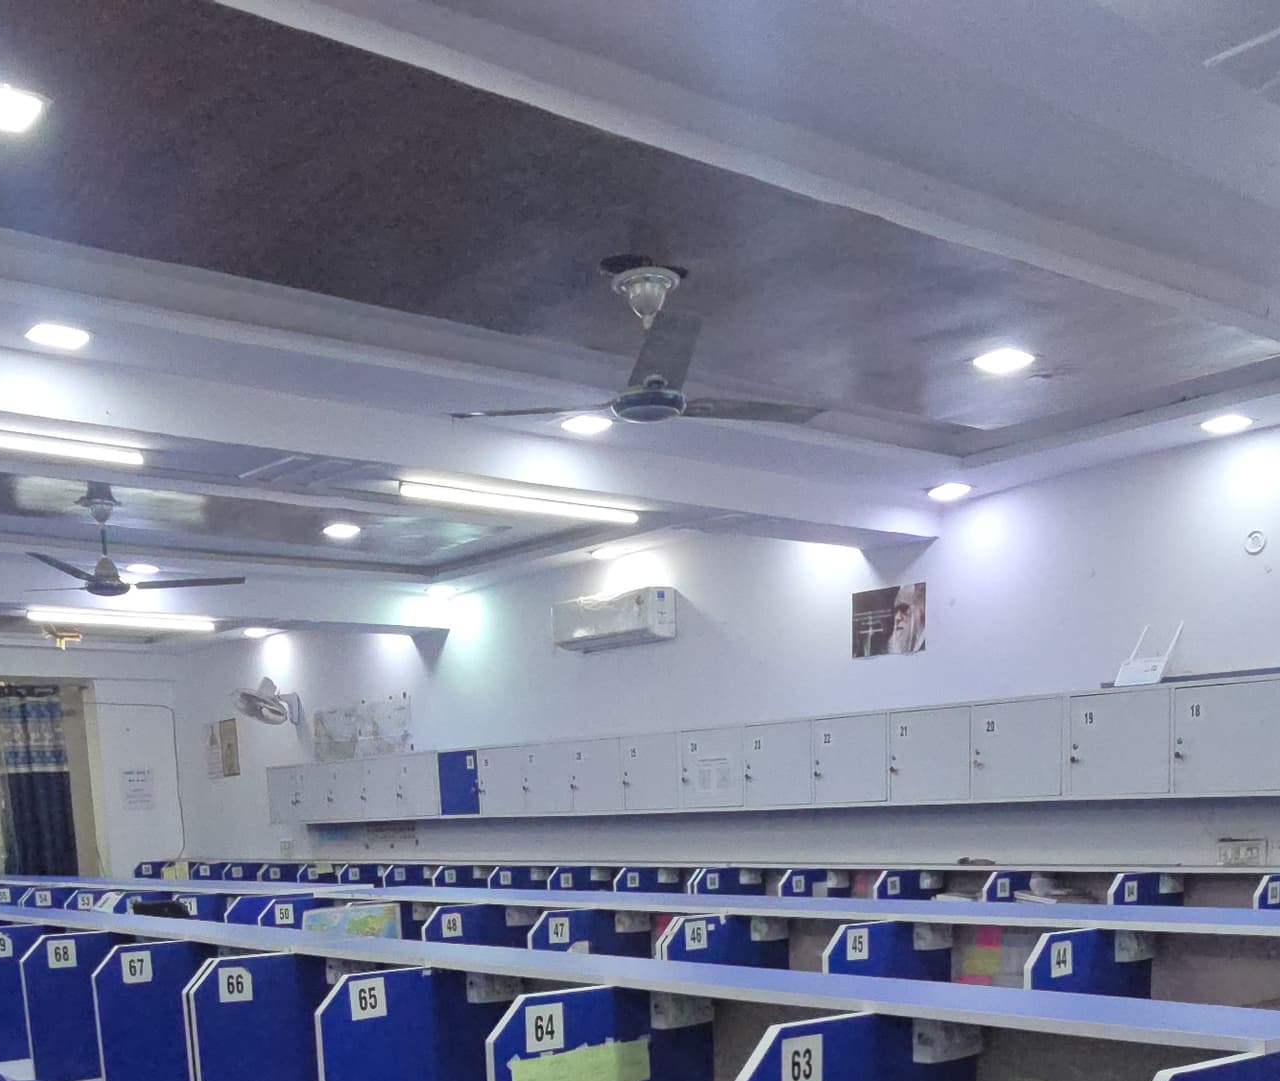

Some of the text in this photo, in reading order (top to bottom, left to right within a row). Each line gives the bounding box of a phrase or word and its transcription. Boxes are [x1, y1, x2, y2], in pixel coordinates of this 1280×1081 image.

[1190, 704, 1201, 718] 18
[899, 725, 908, 737] 21
[986, 720, 995, 732] 20
[279, 908, 290, 920] 50
[446, 918, 457, 932] 48
[553, 923, 564, 938] 47
[690, 927, 702, 944] 46
[851, 935, 863, 953] 45
[54, 946, 69, 962] 68
[1055, 948, 1067, 968] 44
[129, 958, 144, 976] 67
[226, 974, 244, 994] 66
[357, 987, 378, 1012] 65
[534, 1013, 555, 1042] 64
[791, 1048, 813, 1081] 63
